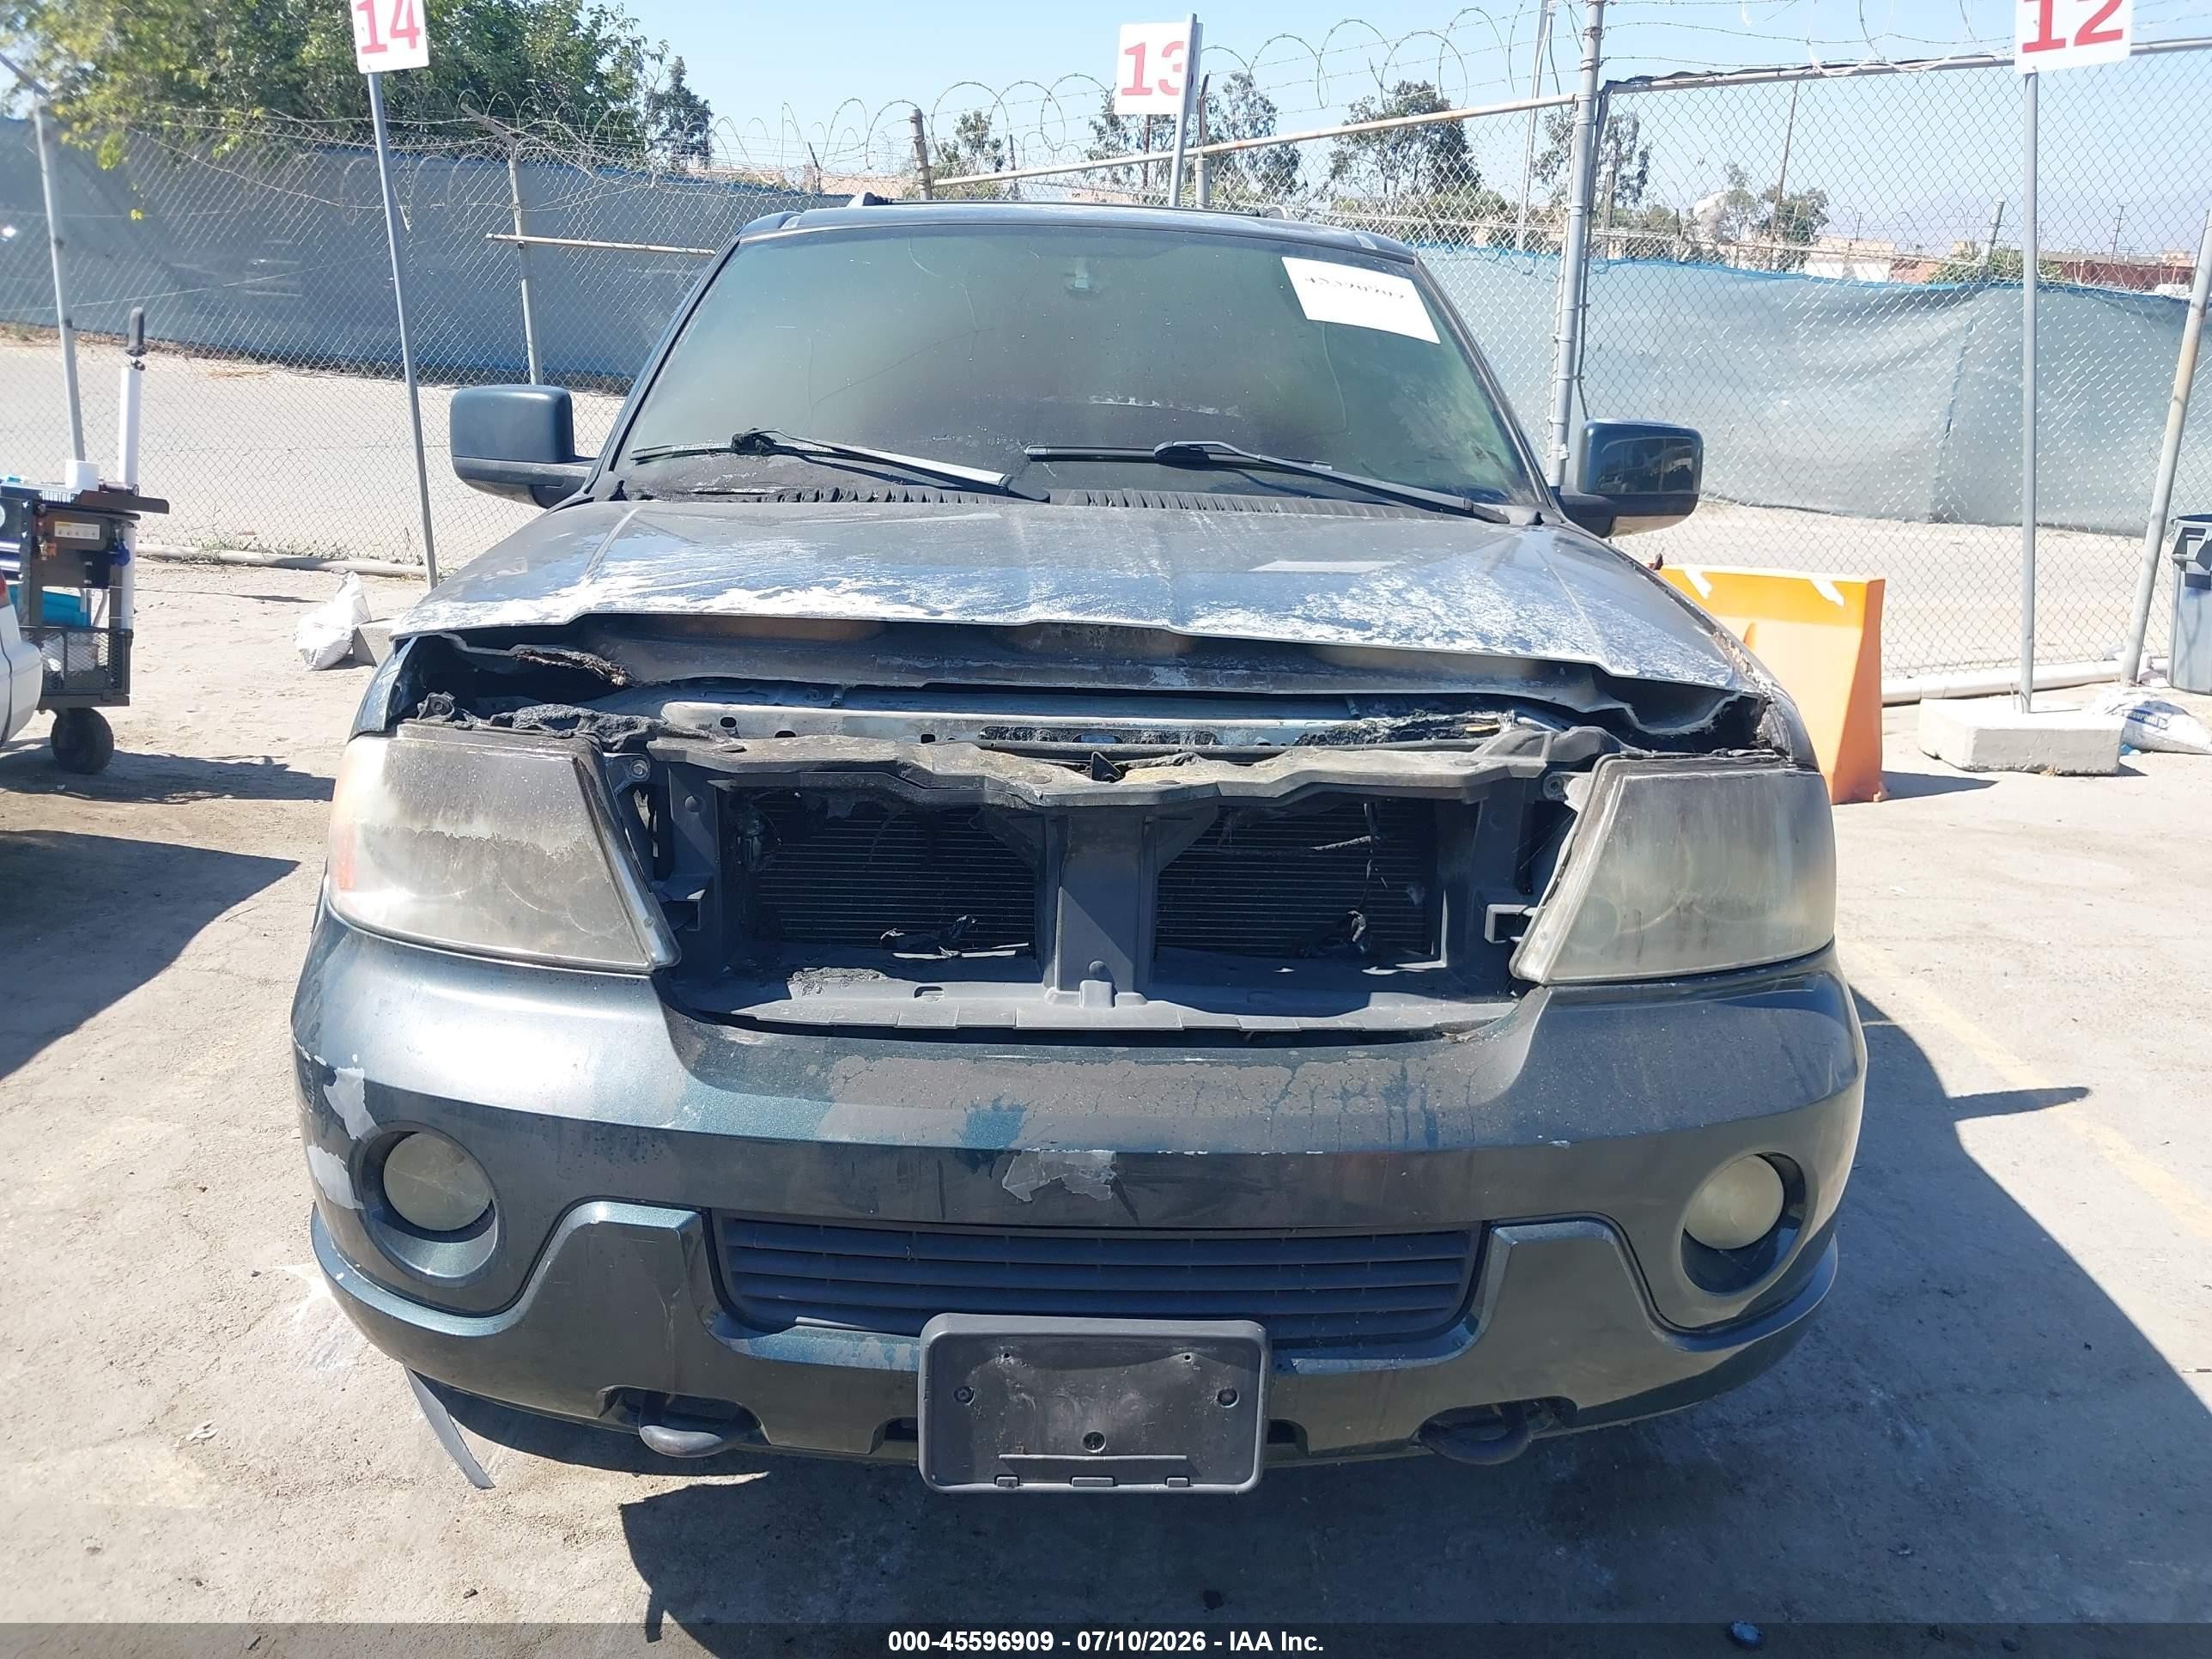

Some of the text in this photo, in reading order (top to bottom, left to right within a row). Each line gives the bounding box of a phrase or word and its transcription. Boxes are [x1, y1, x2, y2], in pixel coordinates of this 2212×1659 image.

[356, 0, 420, 54] 14
[2022, 0, 2124, 53] 12
[1121, 40, 1185, 96] 13
